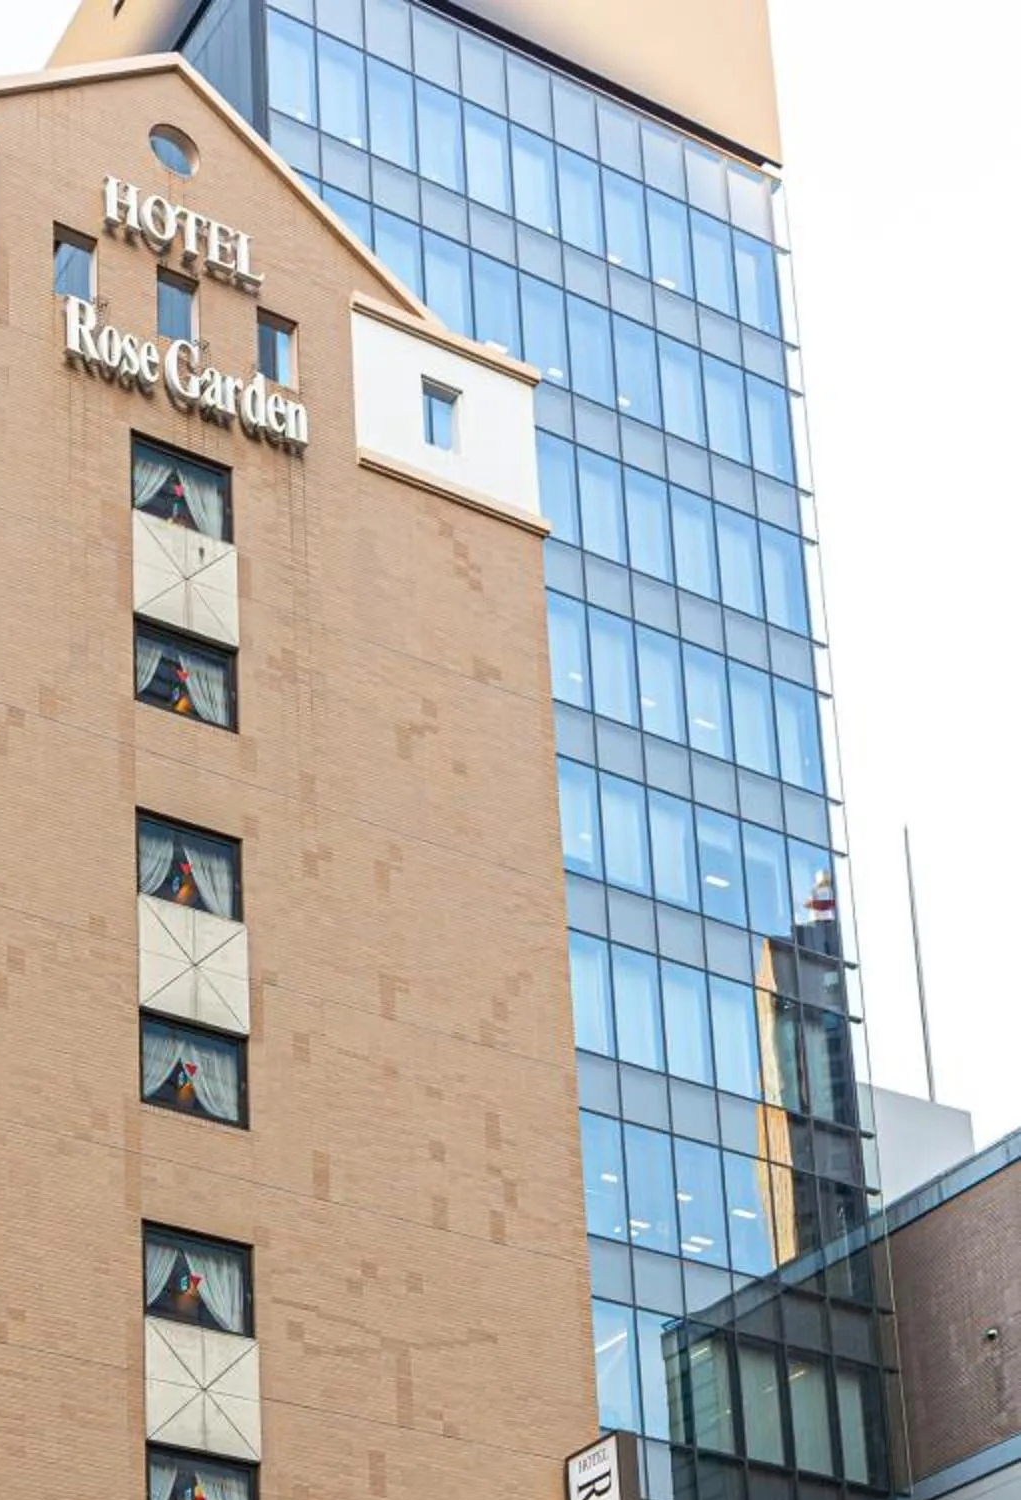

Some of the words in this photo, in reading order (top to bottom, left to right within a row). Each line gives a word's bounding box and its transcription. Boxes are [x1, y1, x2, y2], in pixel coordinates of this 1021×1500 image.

[103, 175, 265, 288] HOTEL
[64, 295, 160, 386] Rose
[164, 340, 309, 449] Garden
